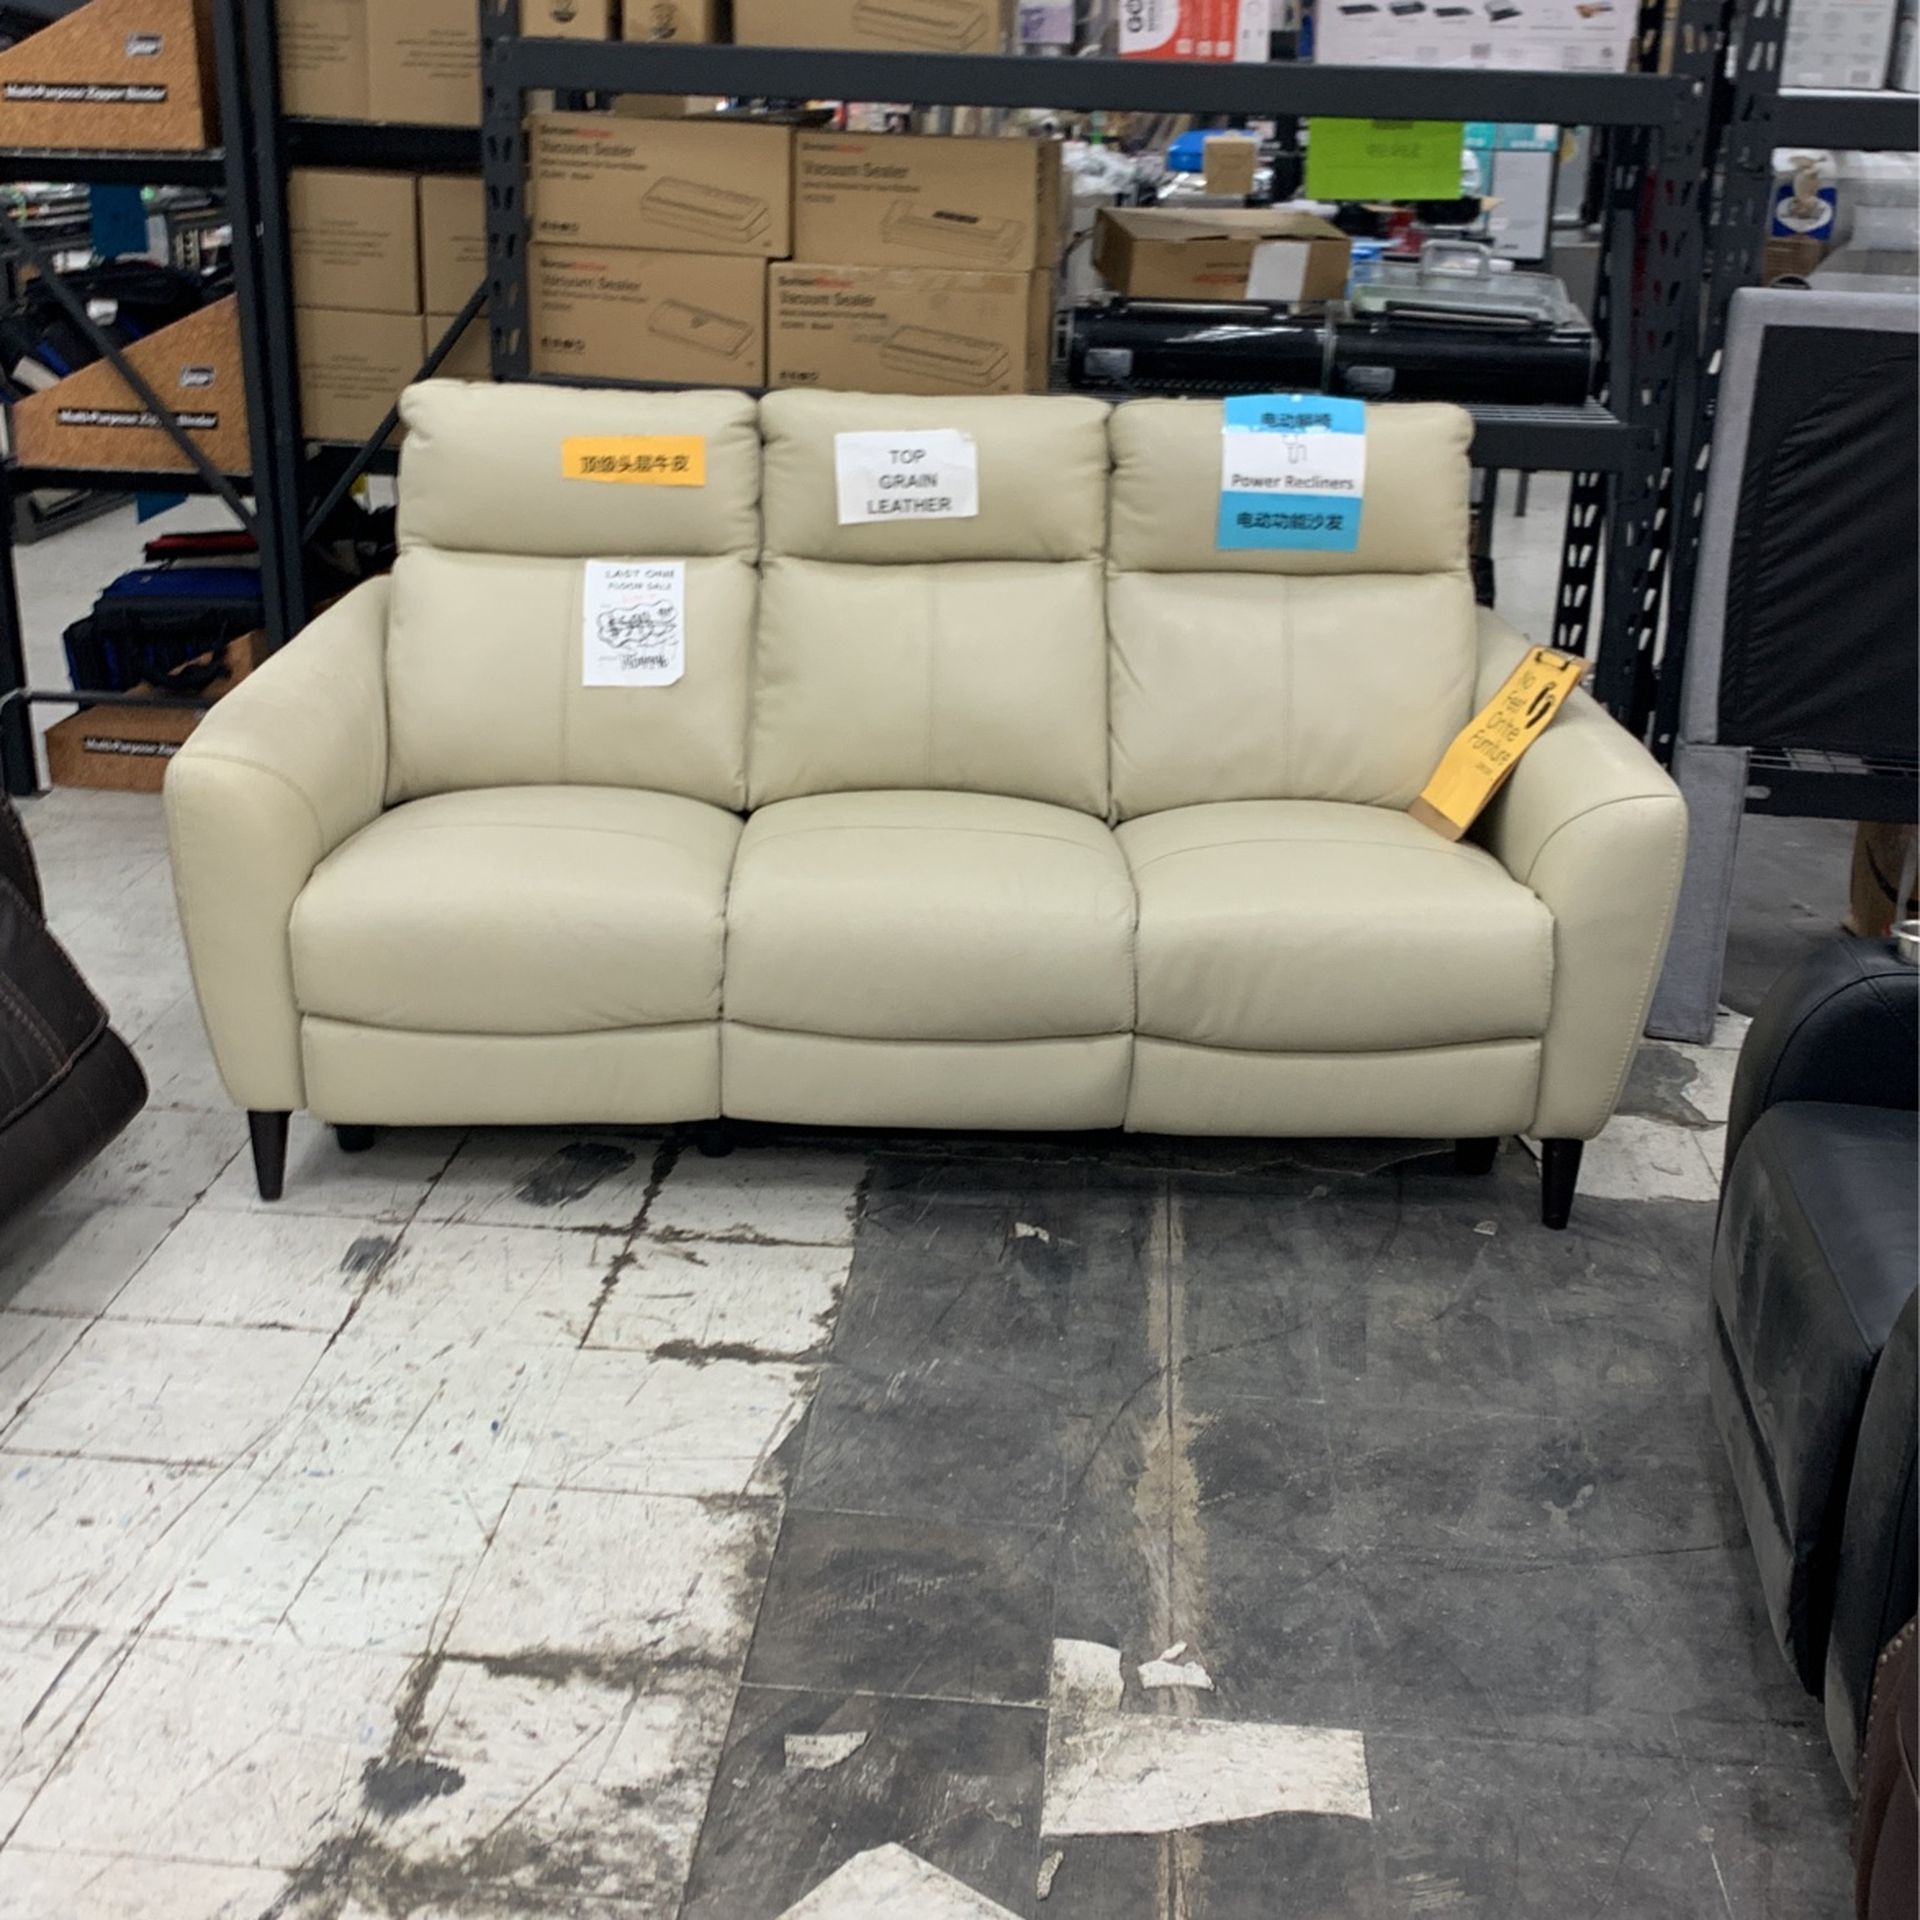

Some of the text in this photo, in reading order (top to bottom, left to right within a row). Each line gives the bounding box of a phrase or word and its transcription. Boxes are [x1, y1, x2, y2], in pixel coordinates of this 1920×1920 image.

[889, 449, 927, 465] TOP
[878, 473, 939, 490] GRAIN
[1230, 473, 1355, 490] Power Recliners
[866, 497, 953, 515] LEATHER
